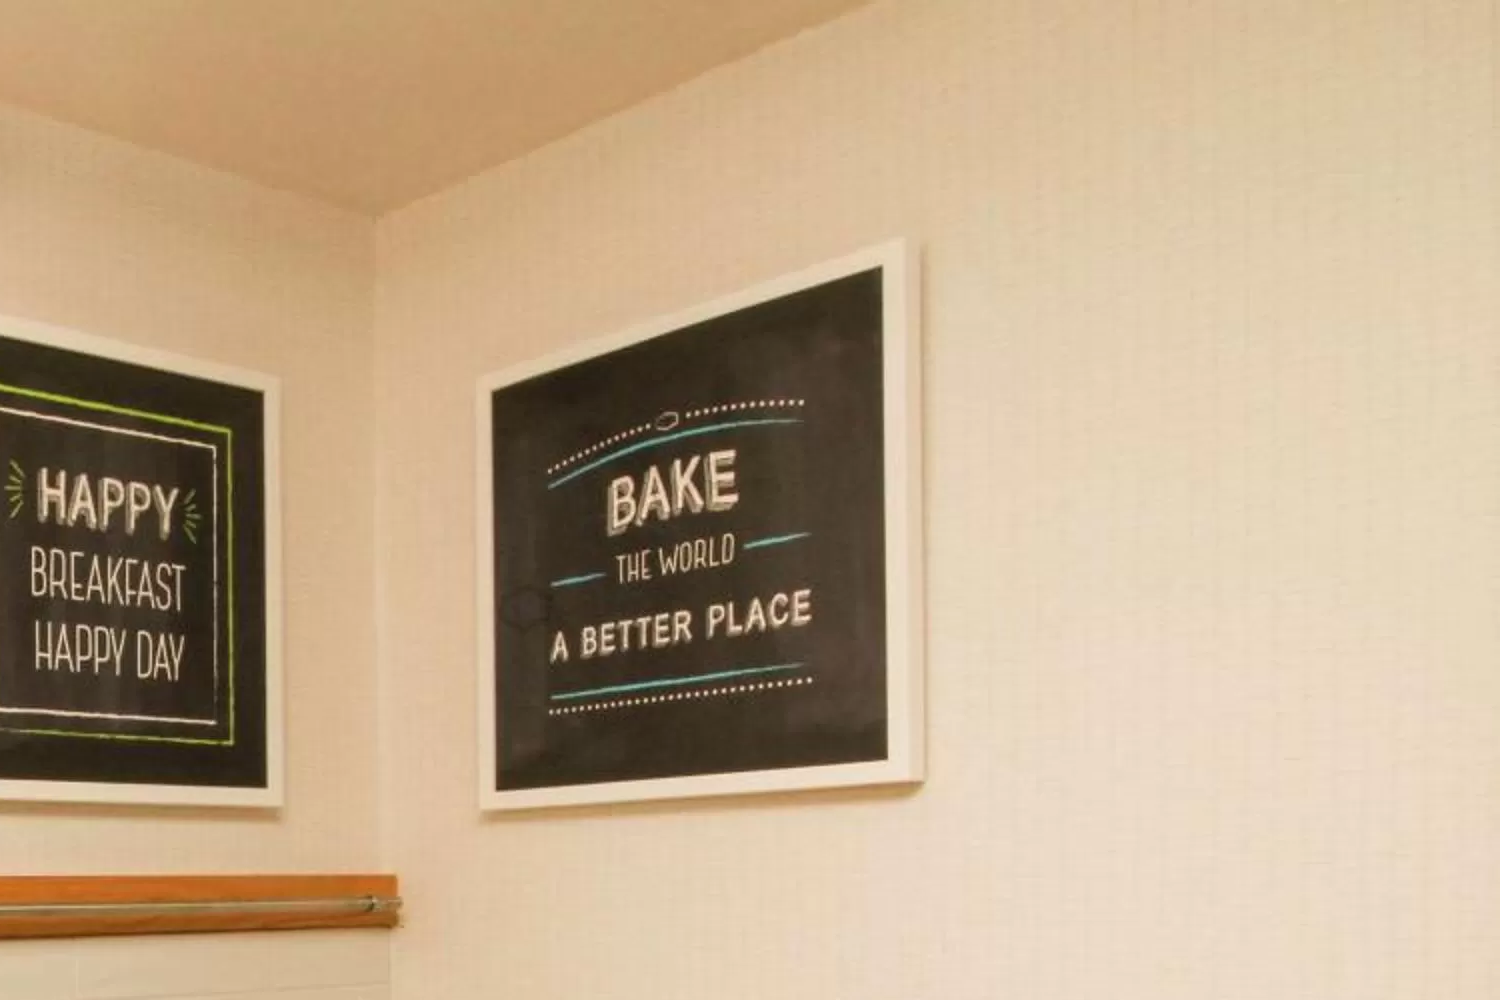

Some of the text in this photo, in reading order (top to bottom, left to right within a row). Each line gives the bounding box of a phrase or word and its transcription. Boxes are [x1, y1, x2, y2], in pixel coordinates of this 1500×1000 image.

[36, 465, 180, 542] HAPPY
[606, 449, 740, 538] BAKE
[30, 545, 187, 613] BREAKFAST
[615, 532, 736, 585] THE WORLD
[34, 619, 186, 683] HAPPY DAY
[549, 588, 813, 664] A BETTER PLACE
